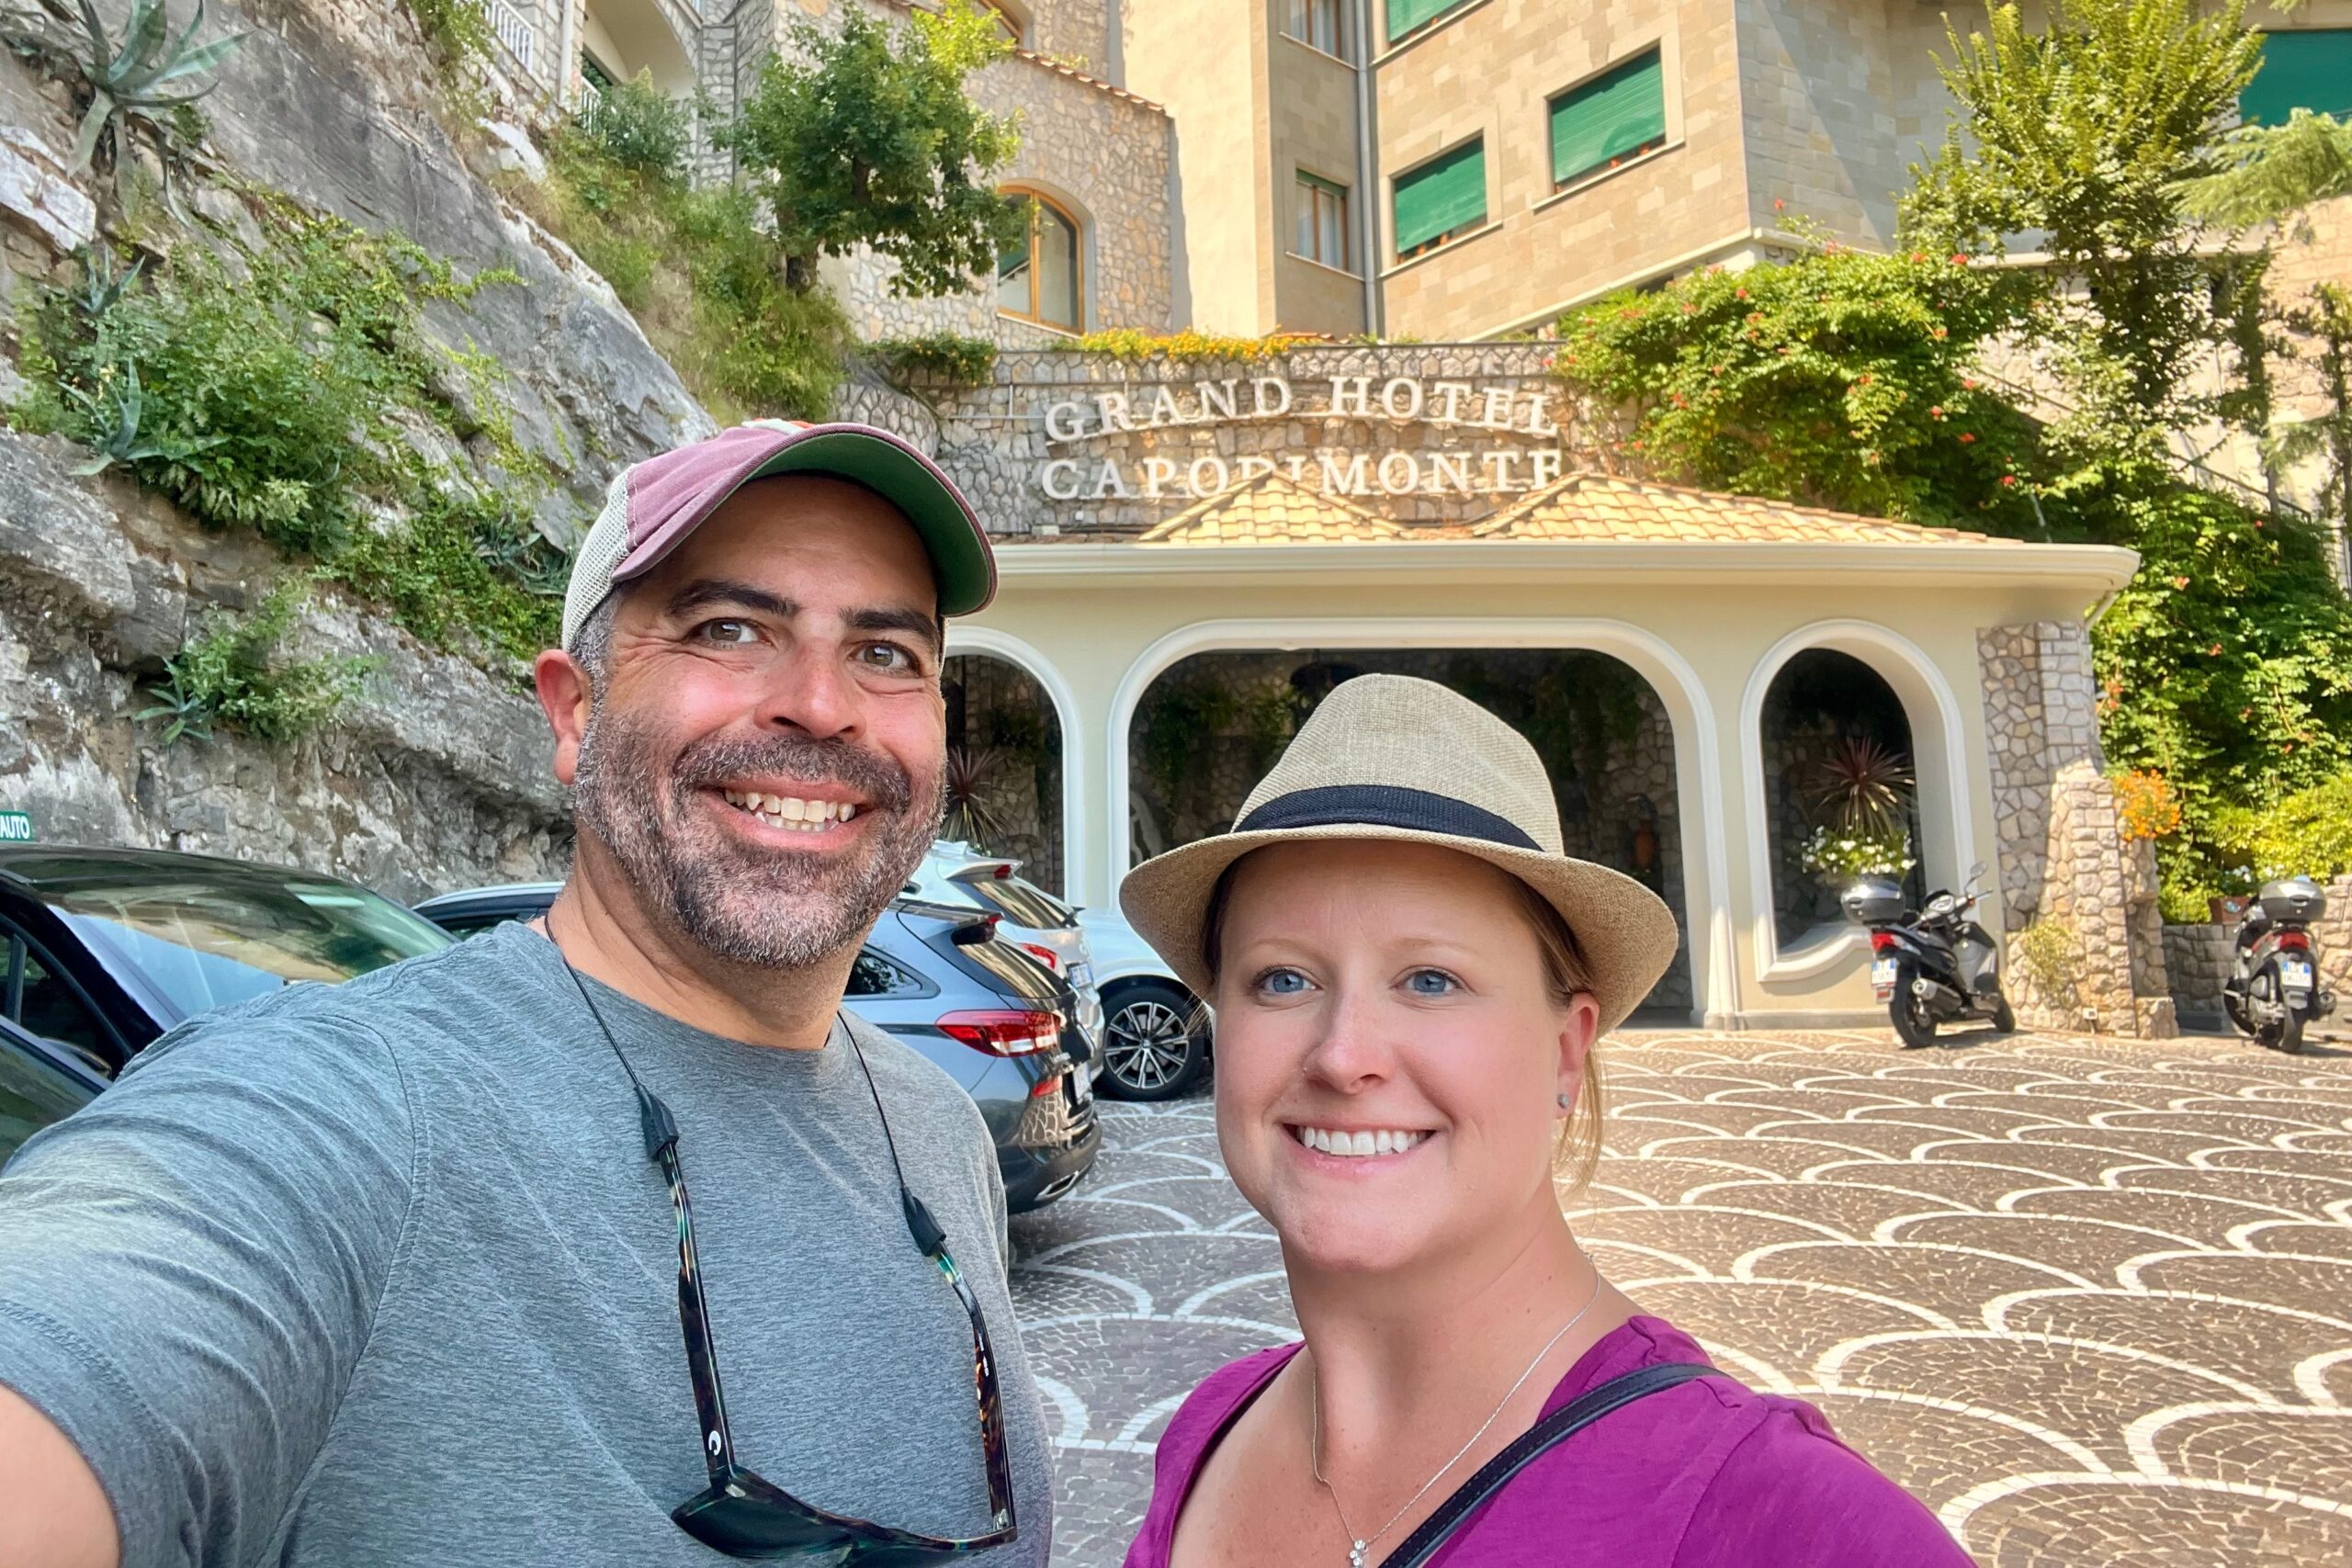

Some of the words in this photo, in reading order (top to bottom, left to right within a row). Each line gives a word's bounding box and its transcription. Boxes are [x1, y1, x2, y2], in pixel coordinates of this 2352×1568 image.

[1045, 377, 1292, 443] GRAND
[1329, 376, 1558, 437] HOTEL
[0, 815, 30, 840] AUTO
